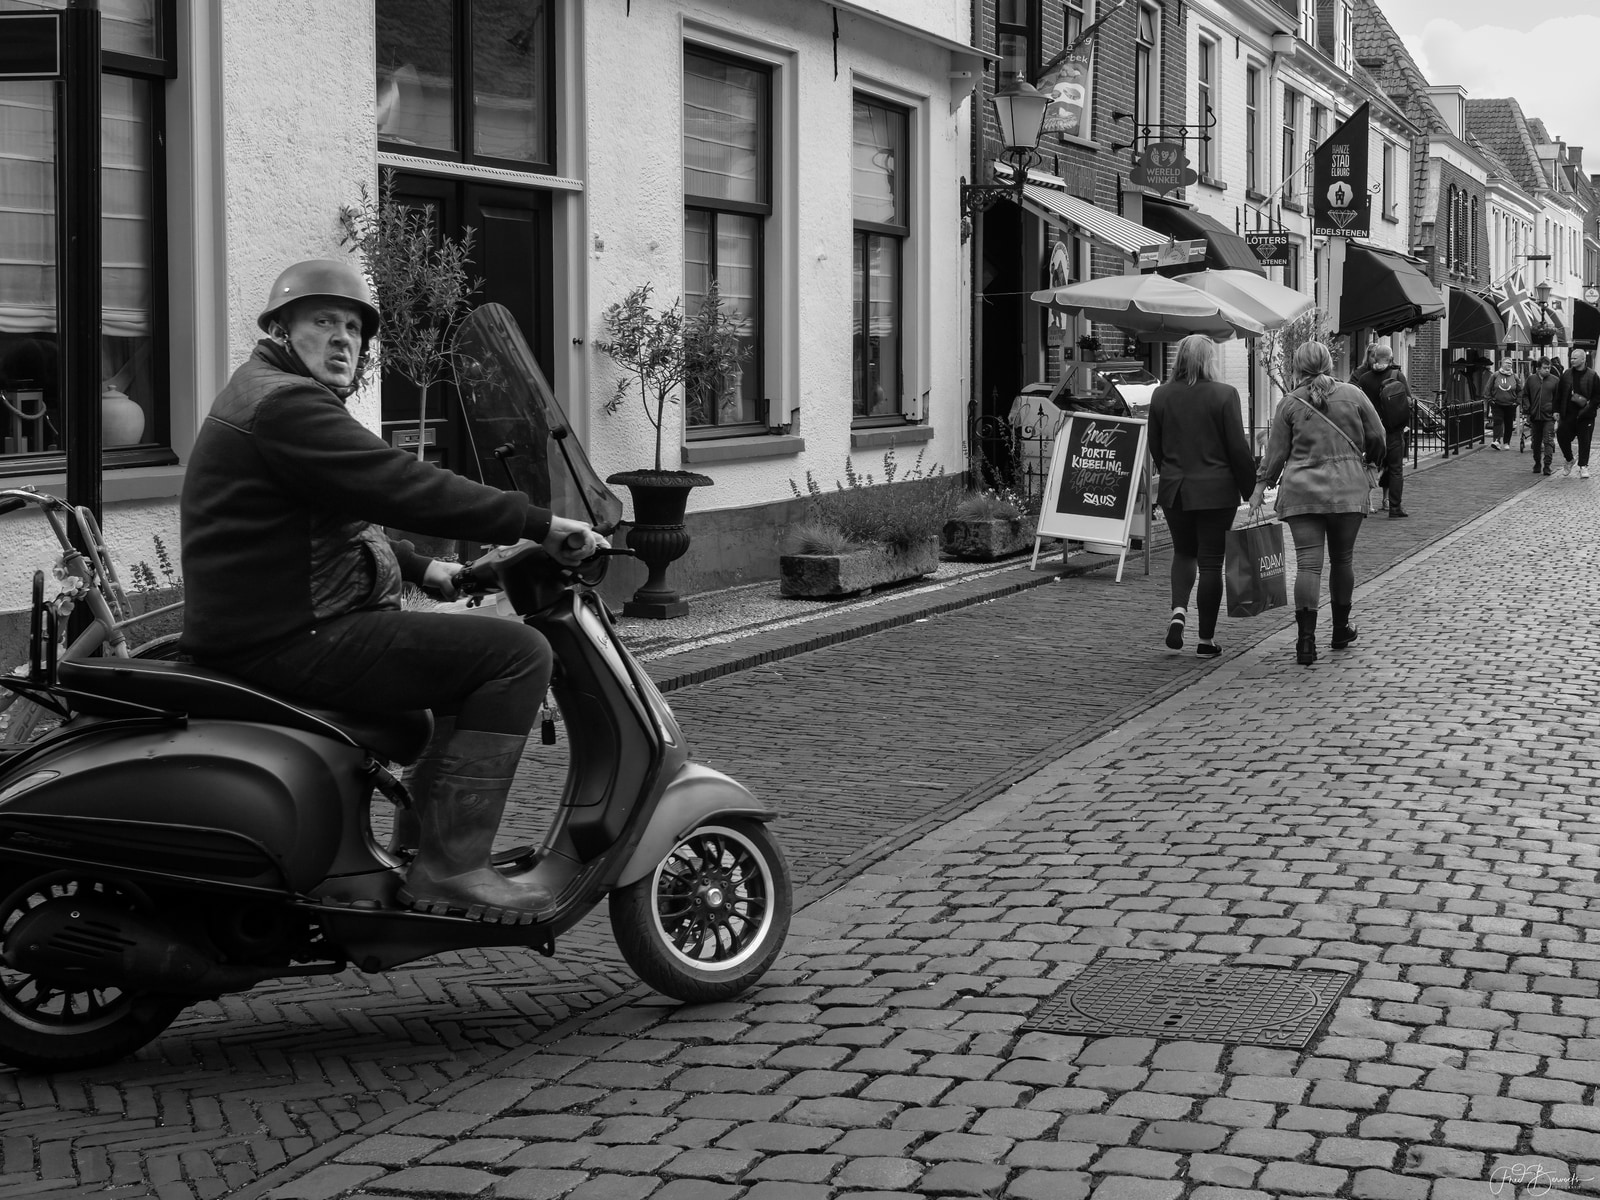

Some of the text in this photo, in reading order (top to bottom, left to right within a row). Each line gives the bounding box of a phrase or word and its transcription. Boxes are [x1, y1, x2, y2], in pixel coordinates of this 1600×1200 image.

[1331, 155, 1350, 168] STAD
[1146, 168, 1181, 176] WERELD
[1331, 167, 1350, 177] ELBURG
[1147, 176, 1180, 184] WINKEL
[1315, 227, 1368, 237] EDELSTENEN
[1081, 446, 1116, 459] PORTIE
[1071, 455, 1122, 476] KIBBELING
[1076, 469, 1116, 489] GRATIS
[1082, 492, 1117, 507] SAUS
